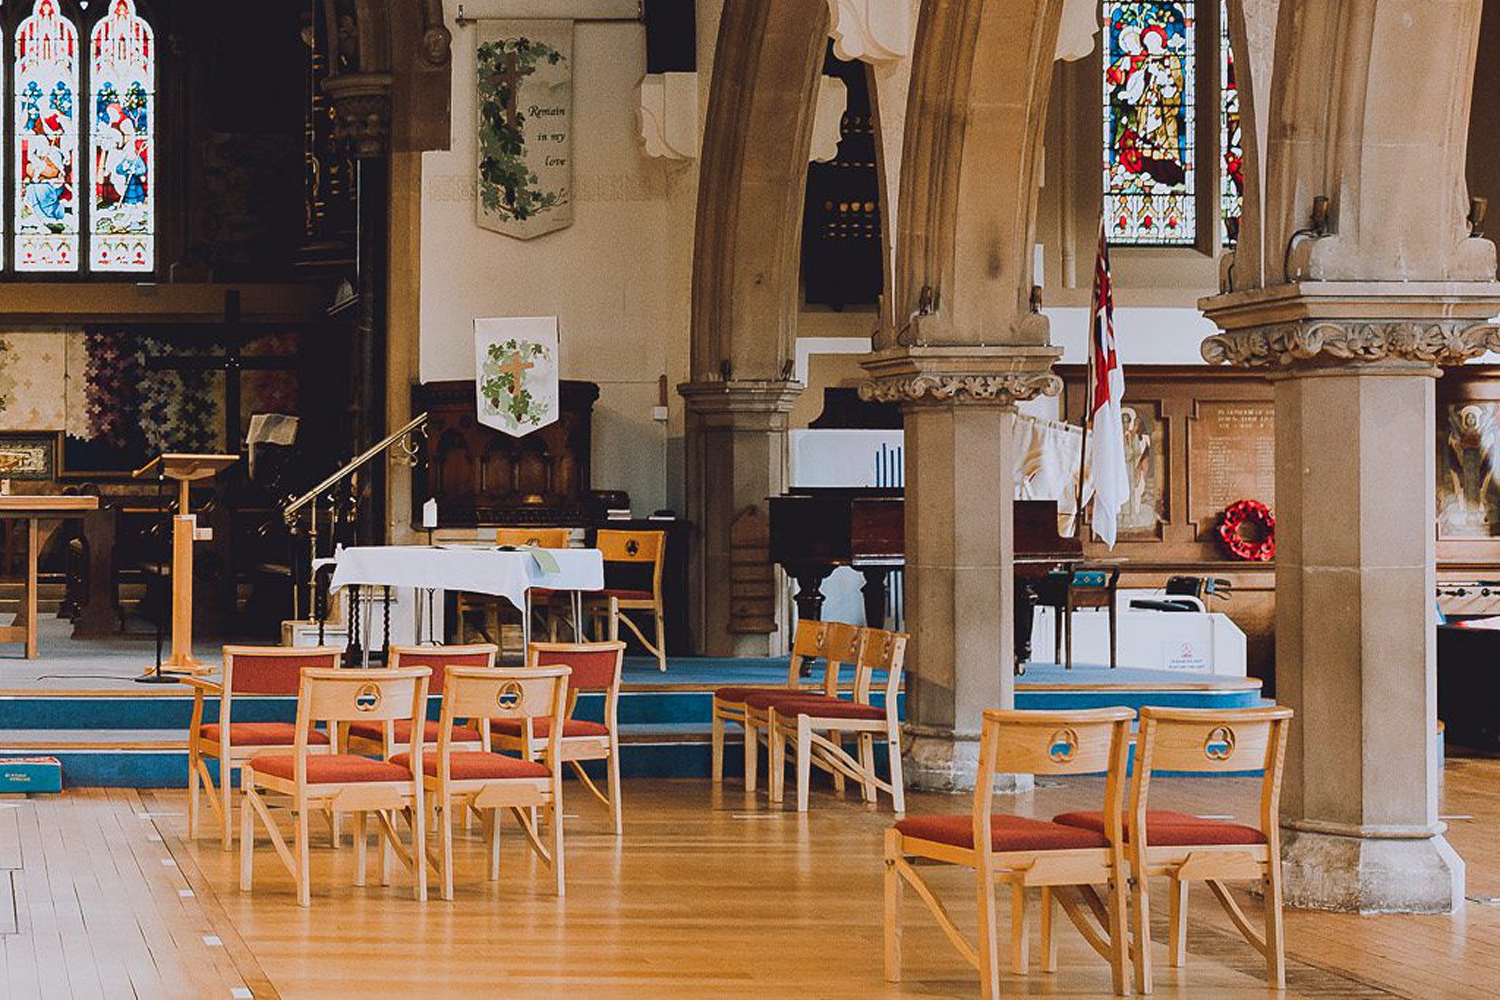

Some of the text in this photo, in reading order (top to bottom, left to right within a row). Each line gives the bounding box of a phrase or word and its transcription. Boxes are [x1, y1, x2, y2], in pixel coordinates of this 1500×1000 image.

[528, 105, 565, 119] Remain
[537, 132, 566, 144] in my
[544, 154, 566, 167] love
